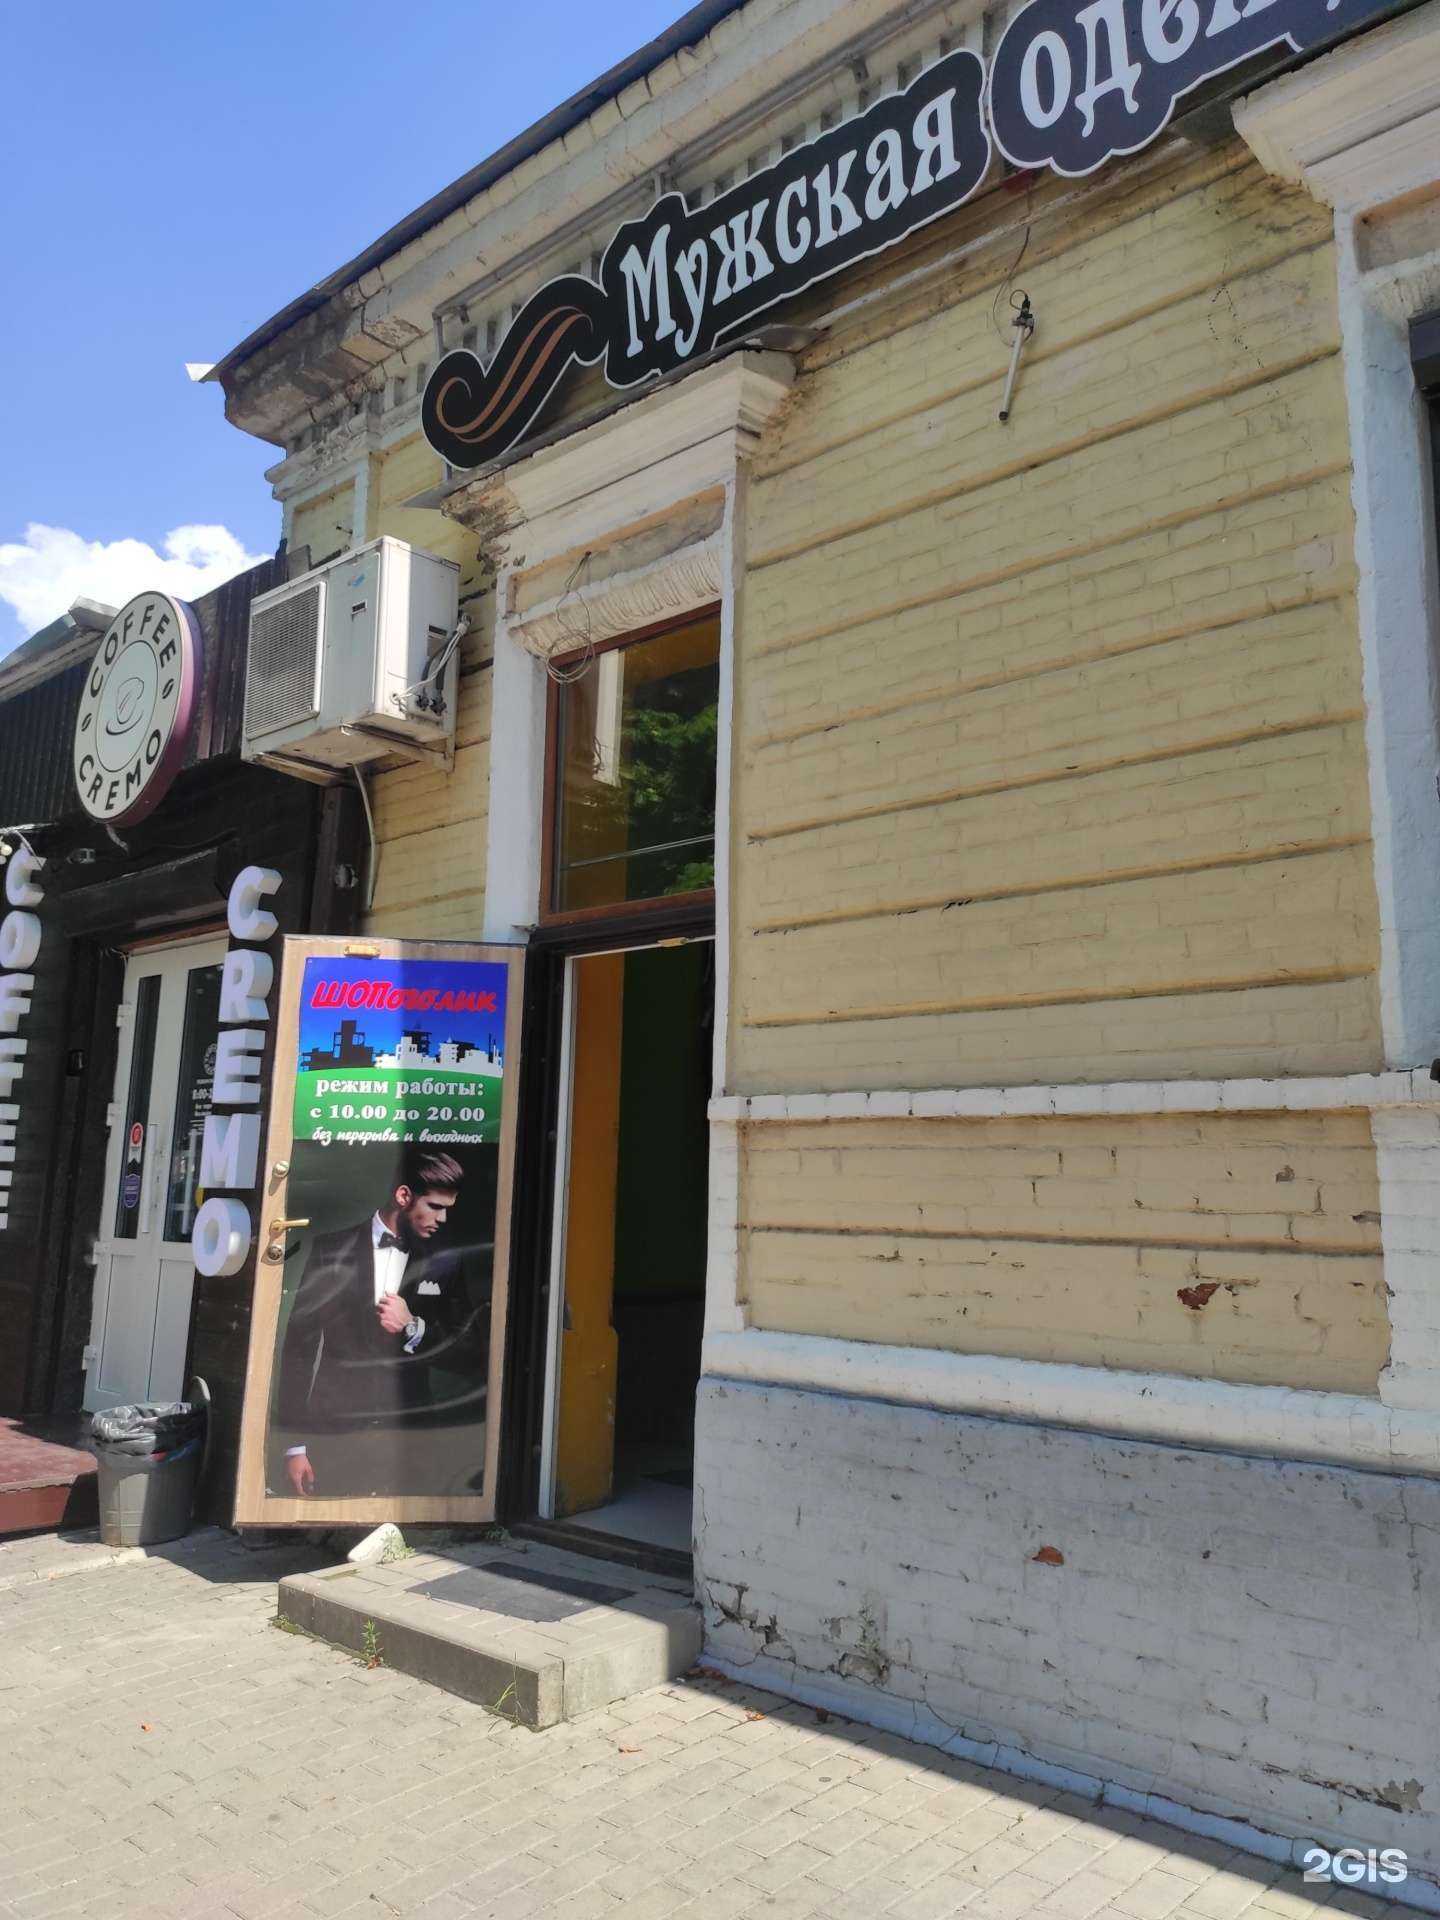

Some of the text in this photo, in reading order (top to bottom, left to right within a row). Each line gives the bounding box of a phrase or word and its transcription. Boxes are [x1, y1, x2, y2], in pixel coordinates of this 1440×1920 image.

[619, 87, 961, 358] Мужская
[90, 604, 176, 698] COFFEE
[79, 729, 161, 811] CREMO
[192, 865, 283, 1277] CREMO
[315, 1077, 484, 1099] режим работы:
[309, 1104, 485, 1122] с 10.00 до 20.00
[311, 1126, 483, 1146] без перерыва и выходных
